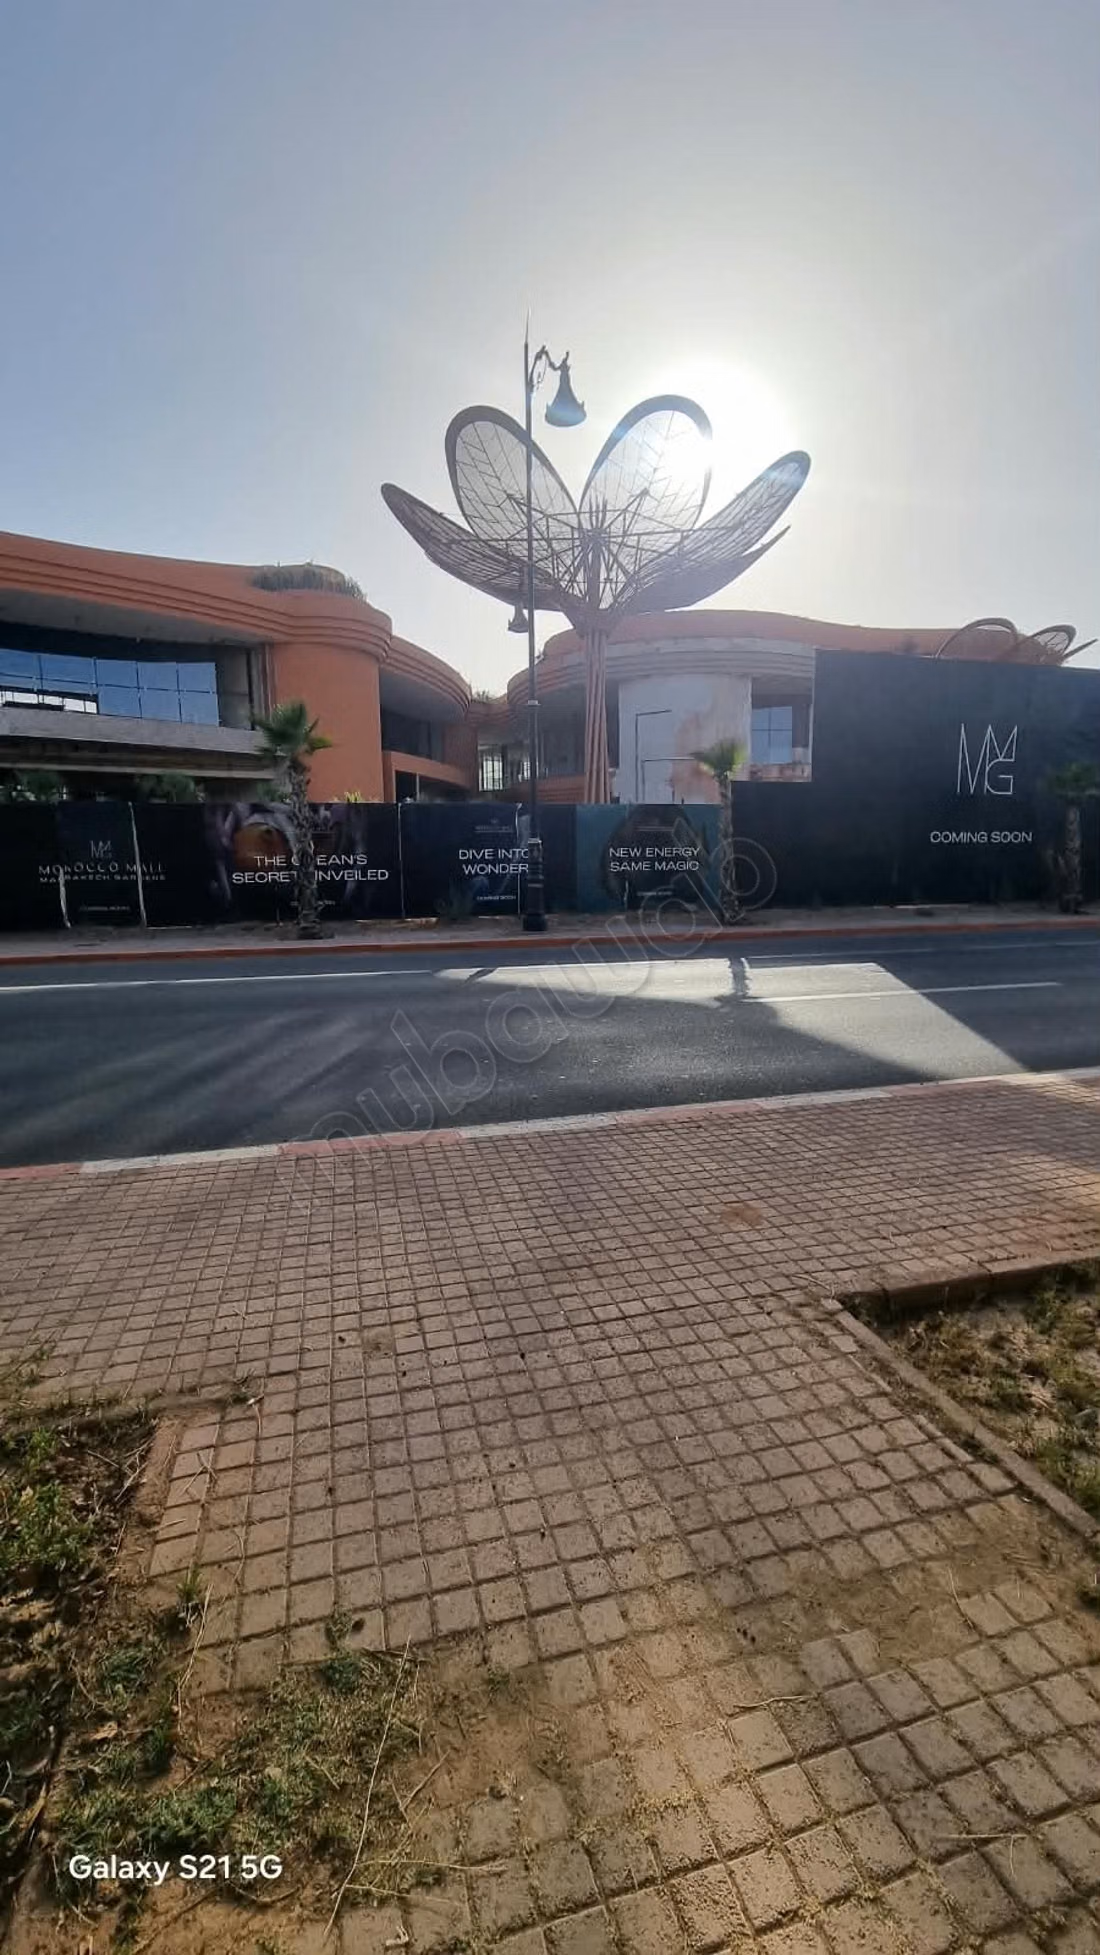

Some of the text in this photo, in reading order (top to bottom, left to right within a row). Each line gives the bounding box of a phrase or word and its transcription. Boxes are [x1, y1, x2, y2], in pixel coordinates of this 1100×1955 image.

[929, 831, 1033, 844] COMING SOON
[459, 847, 495, 860] DIVE
[609, 846, 700, 858] NEW ENERGY
[254, 854, 368, 867] THE OEAN'S
[609, 860, 700, 872] SAME MAGIC
[38, 861, 119, 875] MOROCCO
[462, 863, 529, 875] WONDER
[39, 874, 110, 883] MARAKECH
